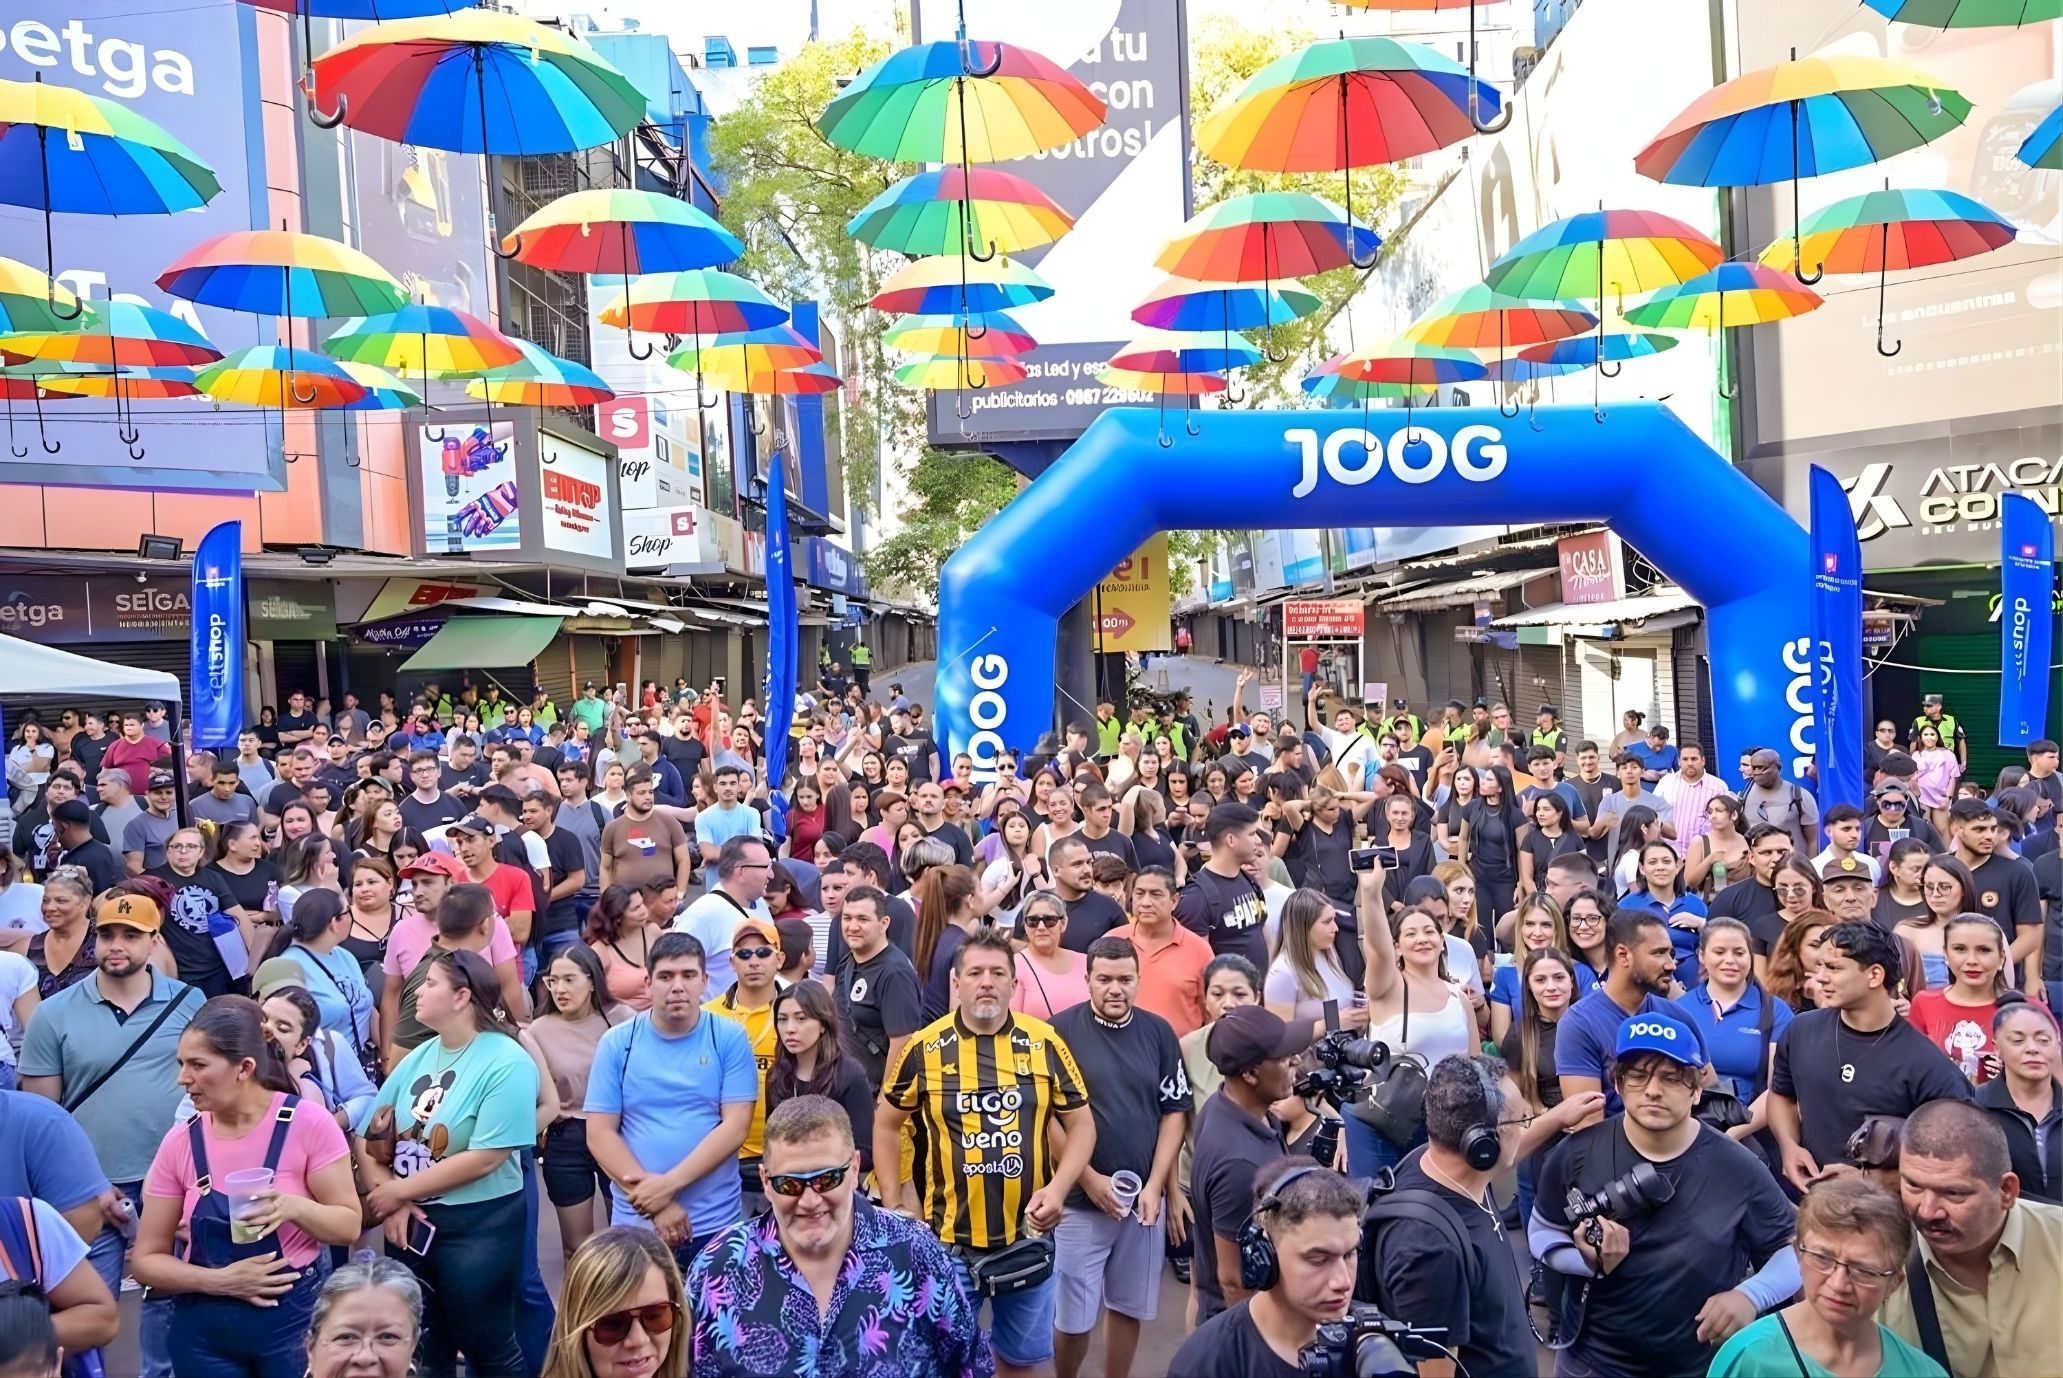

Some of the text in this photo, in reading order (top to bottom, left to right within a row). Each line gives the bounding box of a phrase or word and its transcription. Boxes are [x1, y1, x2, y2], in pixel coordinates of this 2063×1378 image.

[0, 18, 196, 99] etga
[1110, 26, 1148, 62] tu
[612, 408, 638, 438] S
[1284, 425, 1508, 498] JOOG
[630, 535, 669, 556] Shop
[116, 588, 190, 612] SETGA
[961, 1130, 1023, 1150] ueno
